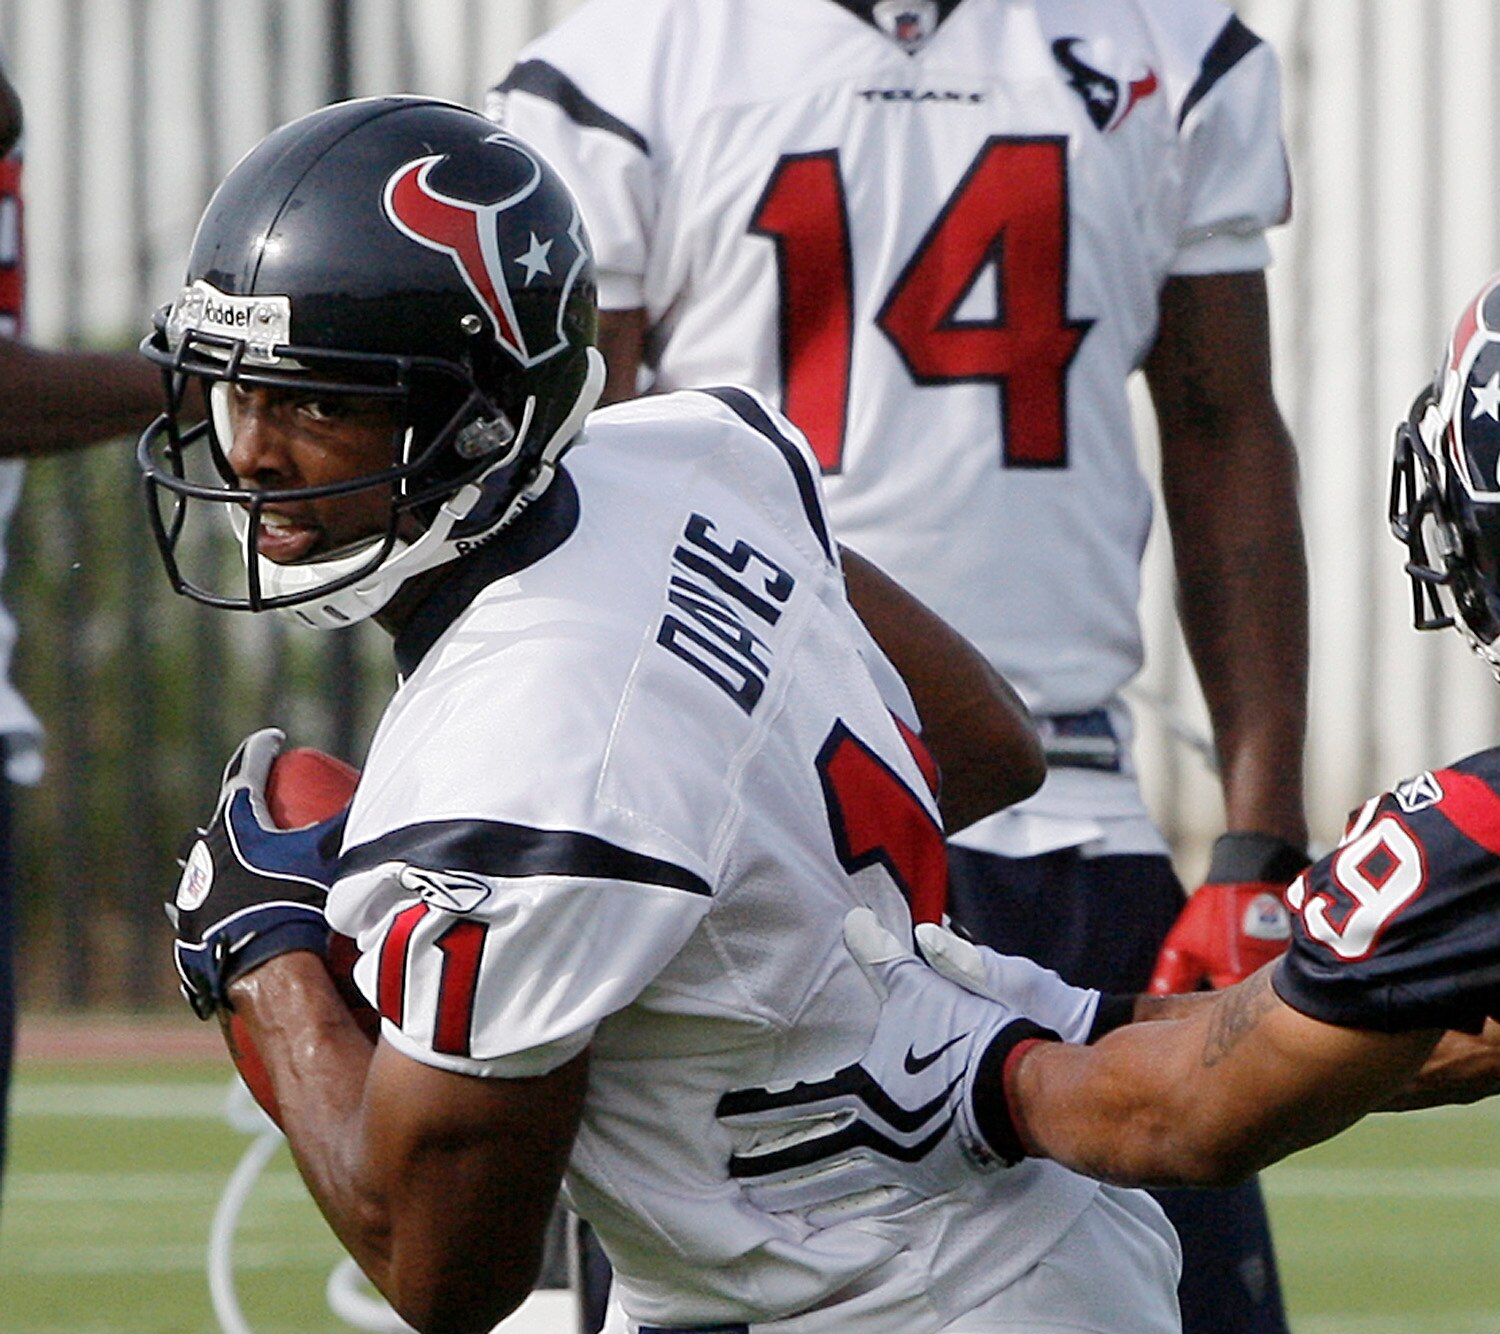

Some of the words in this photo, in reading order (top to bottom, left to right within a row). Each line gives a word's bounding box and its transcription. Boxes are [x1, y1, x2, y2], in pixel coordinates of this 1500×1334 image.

[748, 134, 1097, 476] 14
[656, 512, 795, 717] DAVIS
[376, 900, 491, 1057] 11
